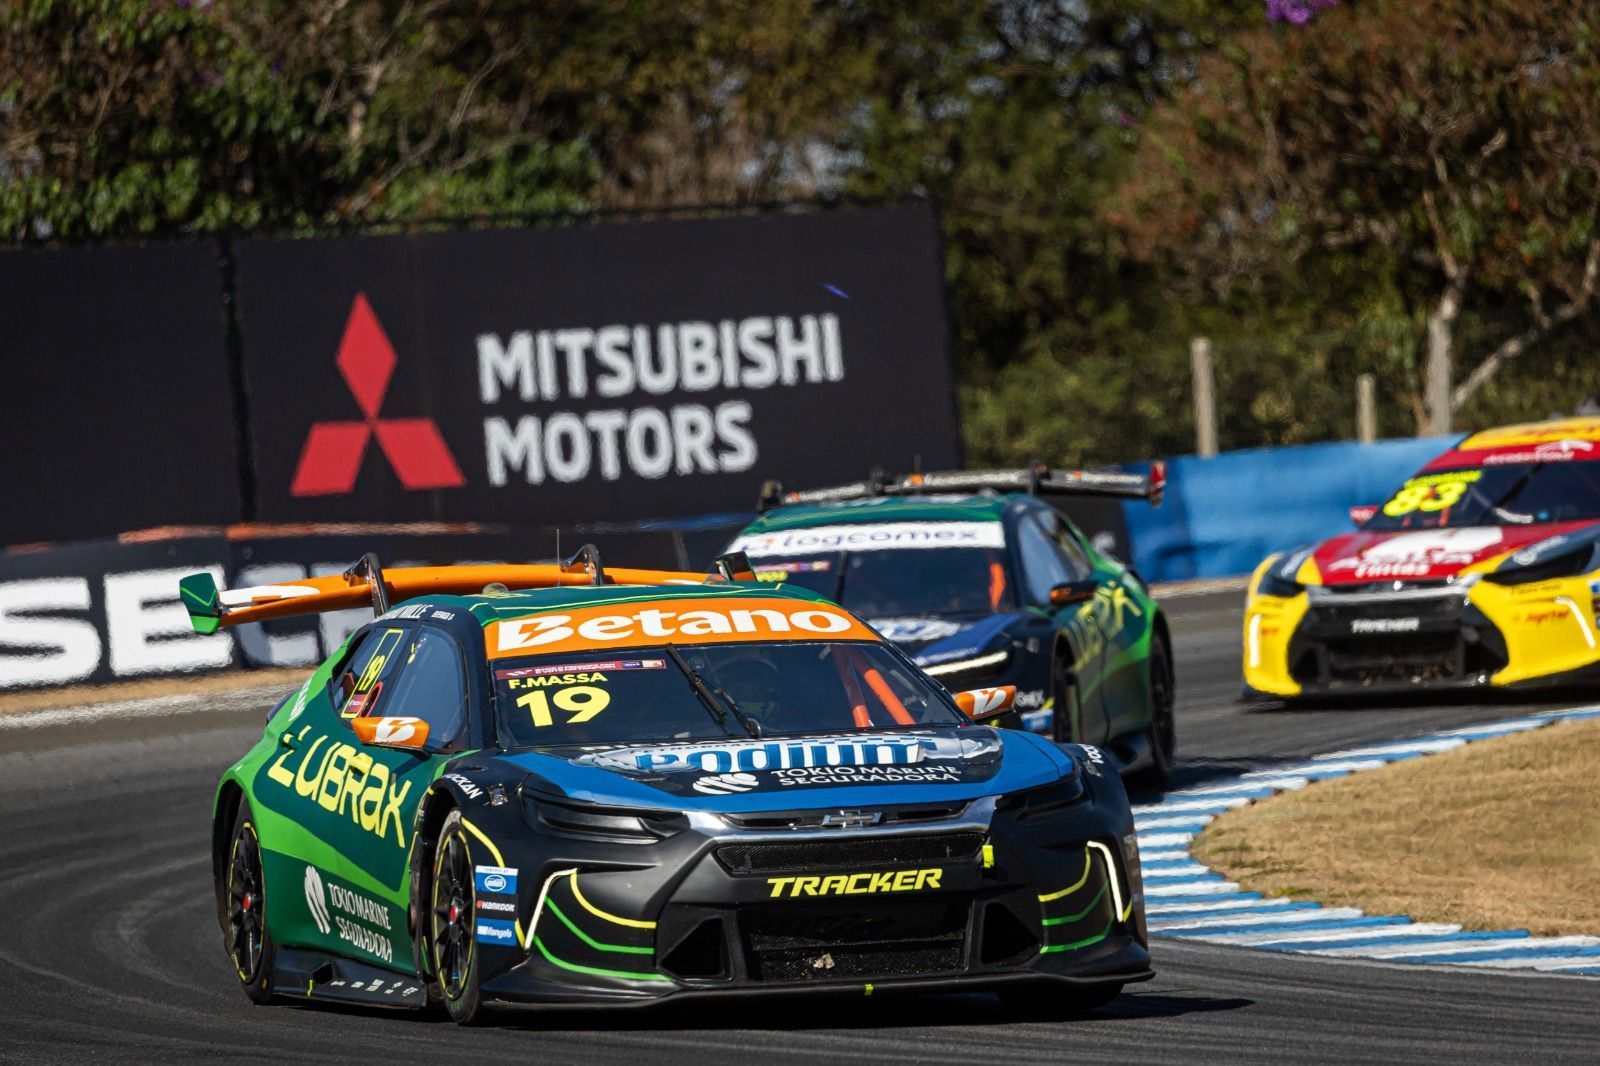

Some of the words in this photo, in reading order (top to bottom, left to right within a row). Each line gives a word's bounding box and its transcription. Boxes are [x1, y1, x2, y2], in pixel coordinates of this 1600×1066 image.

[476, 313, 844, 403] MITSUBISHI
[484, 400, 758, 486] MOTORS
[782, 528, 978, 549] logcomex
[497, 606, 852, 652] Betano
[508, 671, 608, 690] F.MASSA
[516, 685, 611, 727] 19
[770, 766, 854, 778] TOKIO
[857, 764, 962, 776] MARINE
[779, 773, 961, 786] SEGURADORA
[766, 868, 943, 898] TRACKER
[328, 882, 356, 915] TOKIO
[354, 893, 391, 931] MARINE
[335, 915, 392, 963] SEGURADORA
